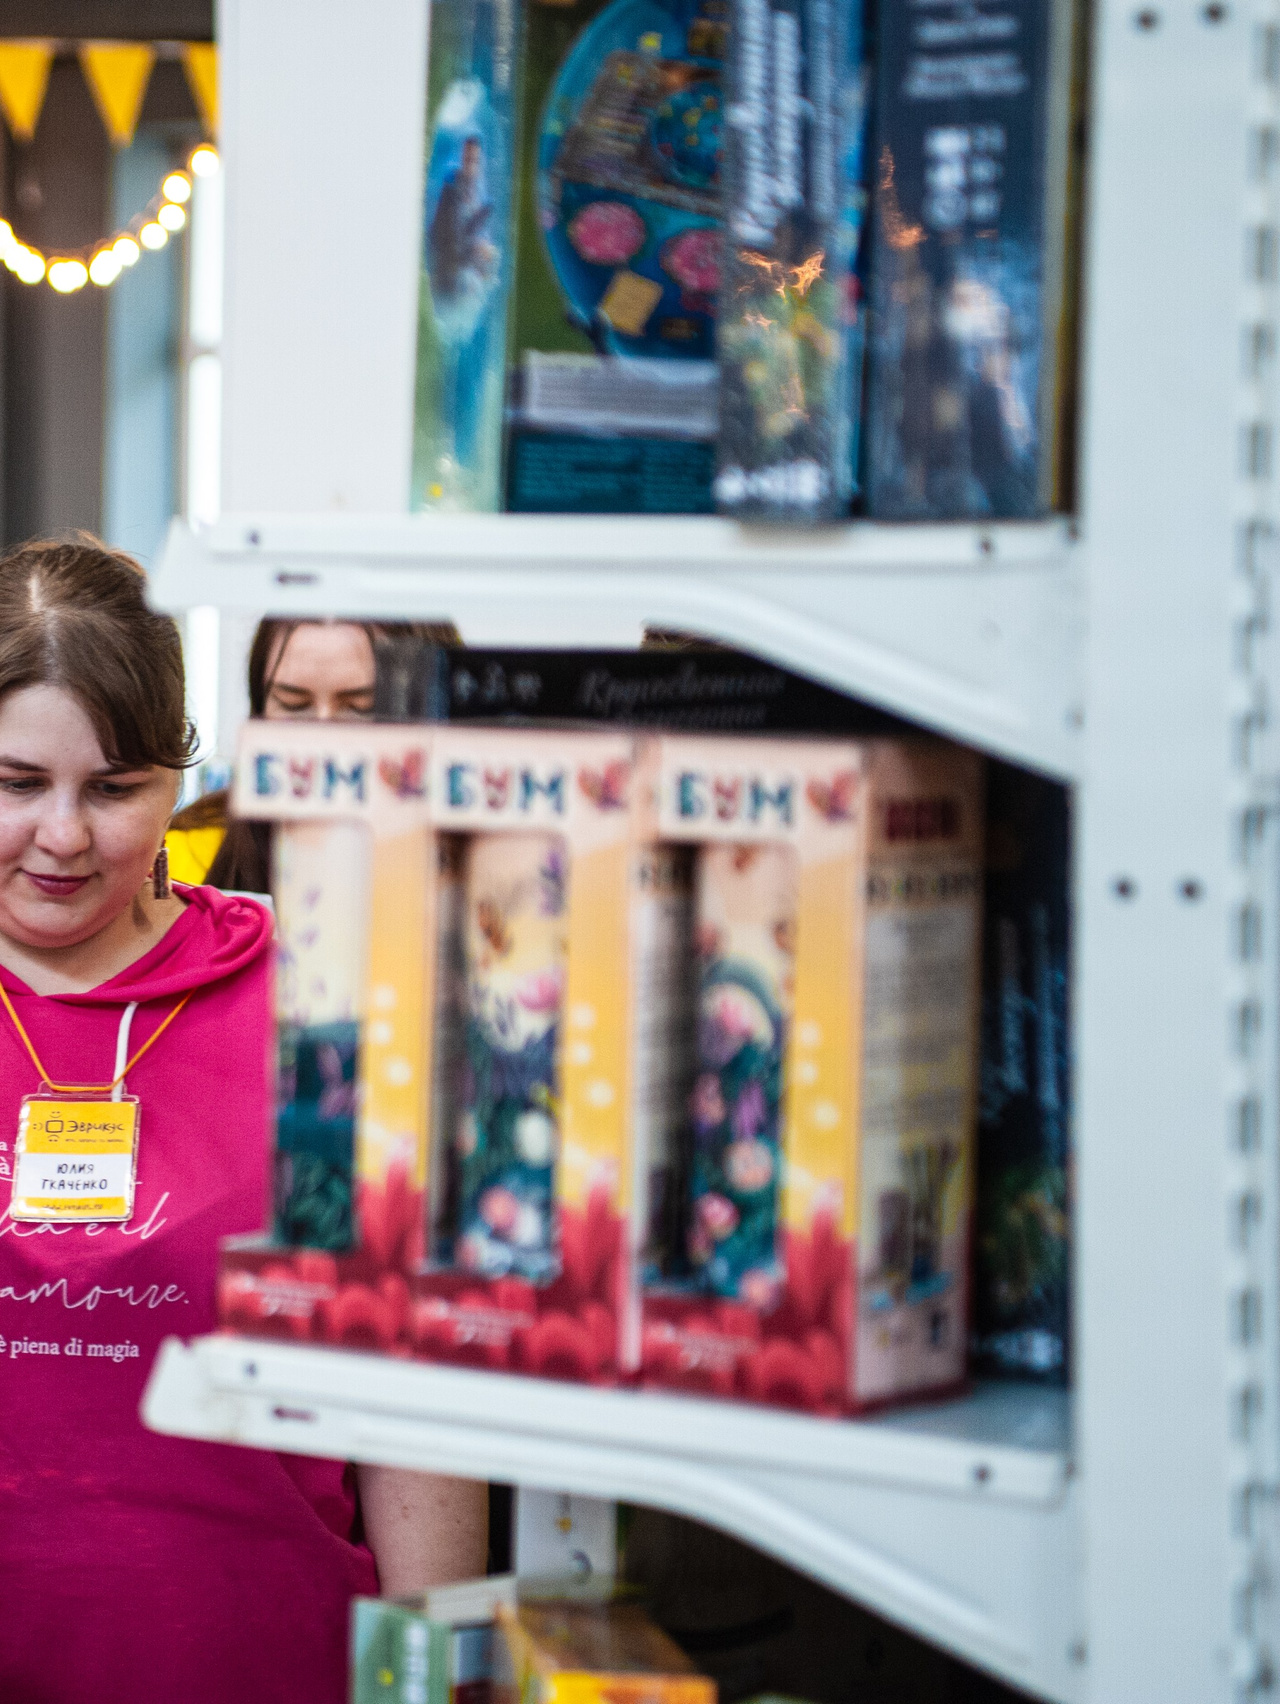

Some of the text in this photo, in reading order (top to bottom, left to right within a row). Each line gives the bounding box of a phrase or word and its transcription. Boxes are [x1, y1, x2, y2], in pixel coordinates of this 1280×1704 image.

[251, 751, 369, 800] БУМ
[445, 761, 568, 815] БУМ
[676, 771, 794, 827] БУМ
[66, 1120, 125, 1135] Эврикус
[56, 1163, 95, 1175] ЮЛИЯ
[41, 1178, 109, 1191] ТКАЧЕНКО
[10, 1336, 60, 1359] piena
[64, 1337, 83, 1357] di
[87, 1339, 140, 1363] magia
